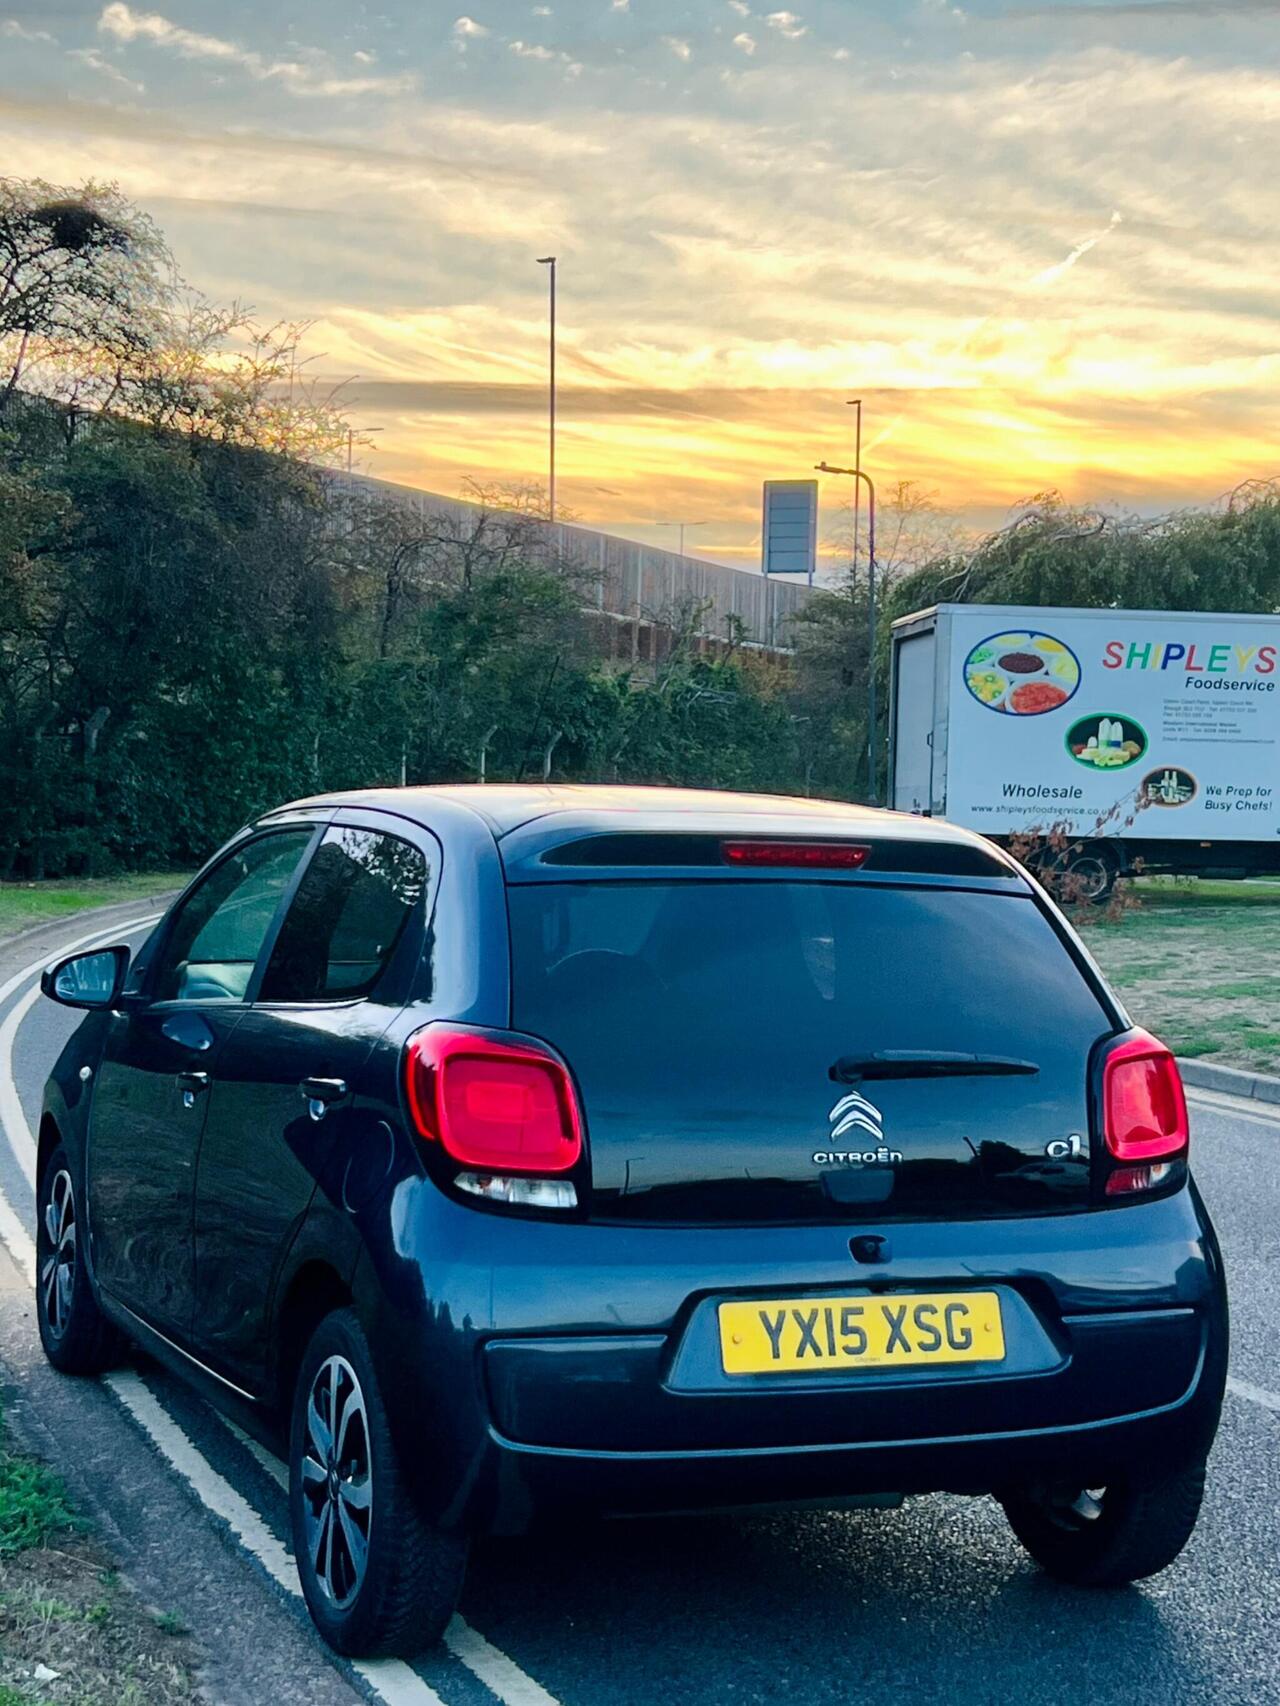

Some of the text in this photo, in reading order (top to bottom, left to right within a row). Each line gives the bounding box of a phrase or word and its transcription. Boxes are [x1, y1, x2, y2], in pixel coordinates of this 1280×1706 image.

[1102, 641, 1277, 674] SHIPLEYS
[1185, 676, 1275, 692] Foodservice
[1002, 783, 1083, 799] Wholesale
[1206, 785, 1273, 799] We Prep for
[1205, 800, 1273, 812] Busy Chefs!
[759, 1303, 972, 1359] YX15 XSG
